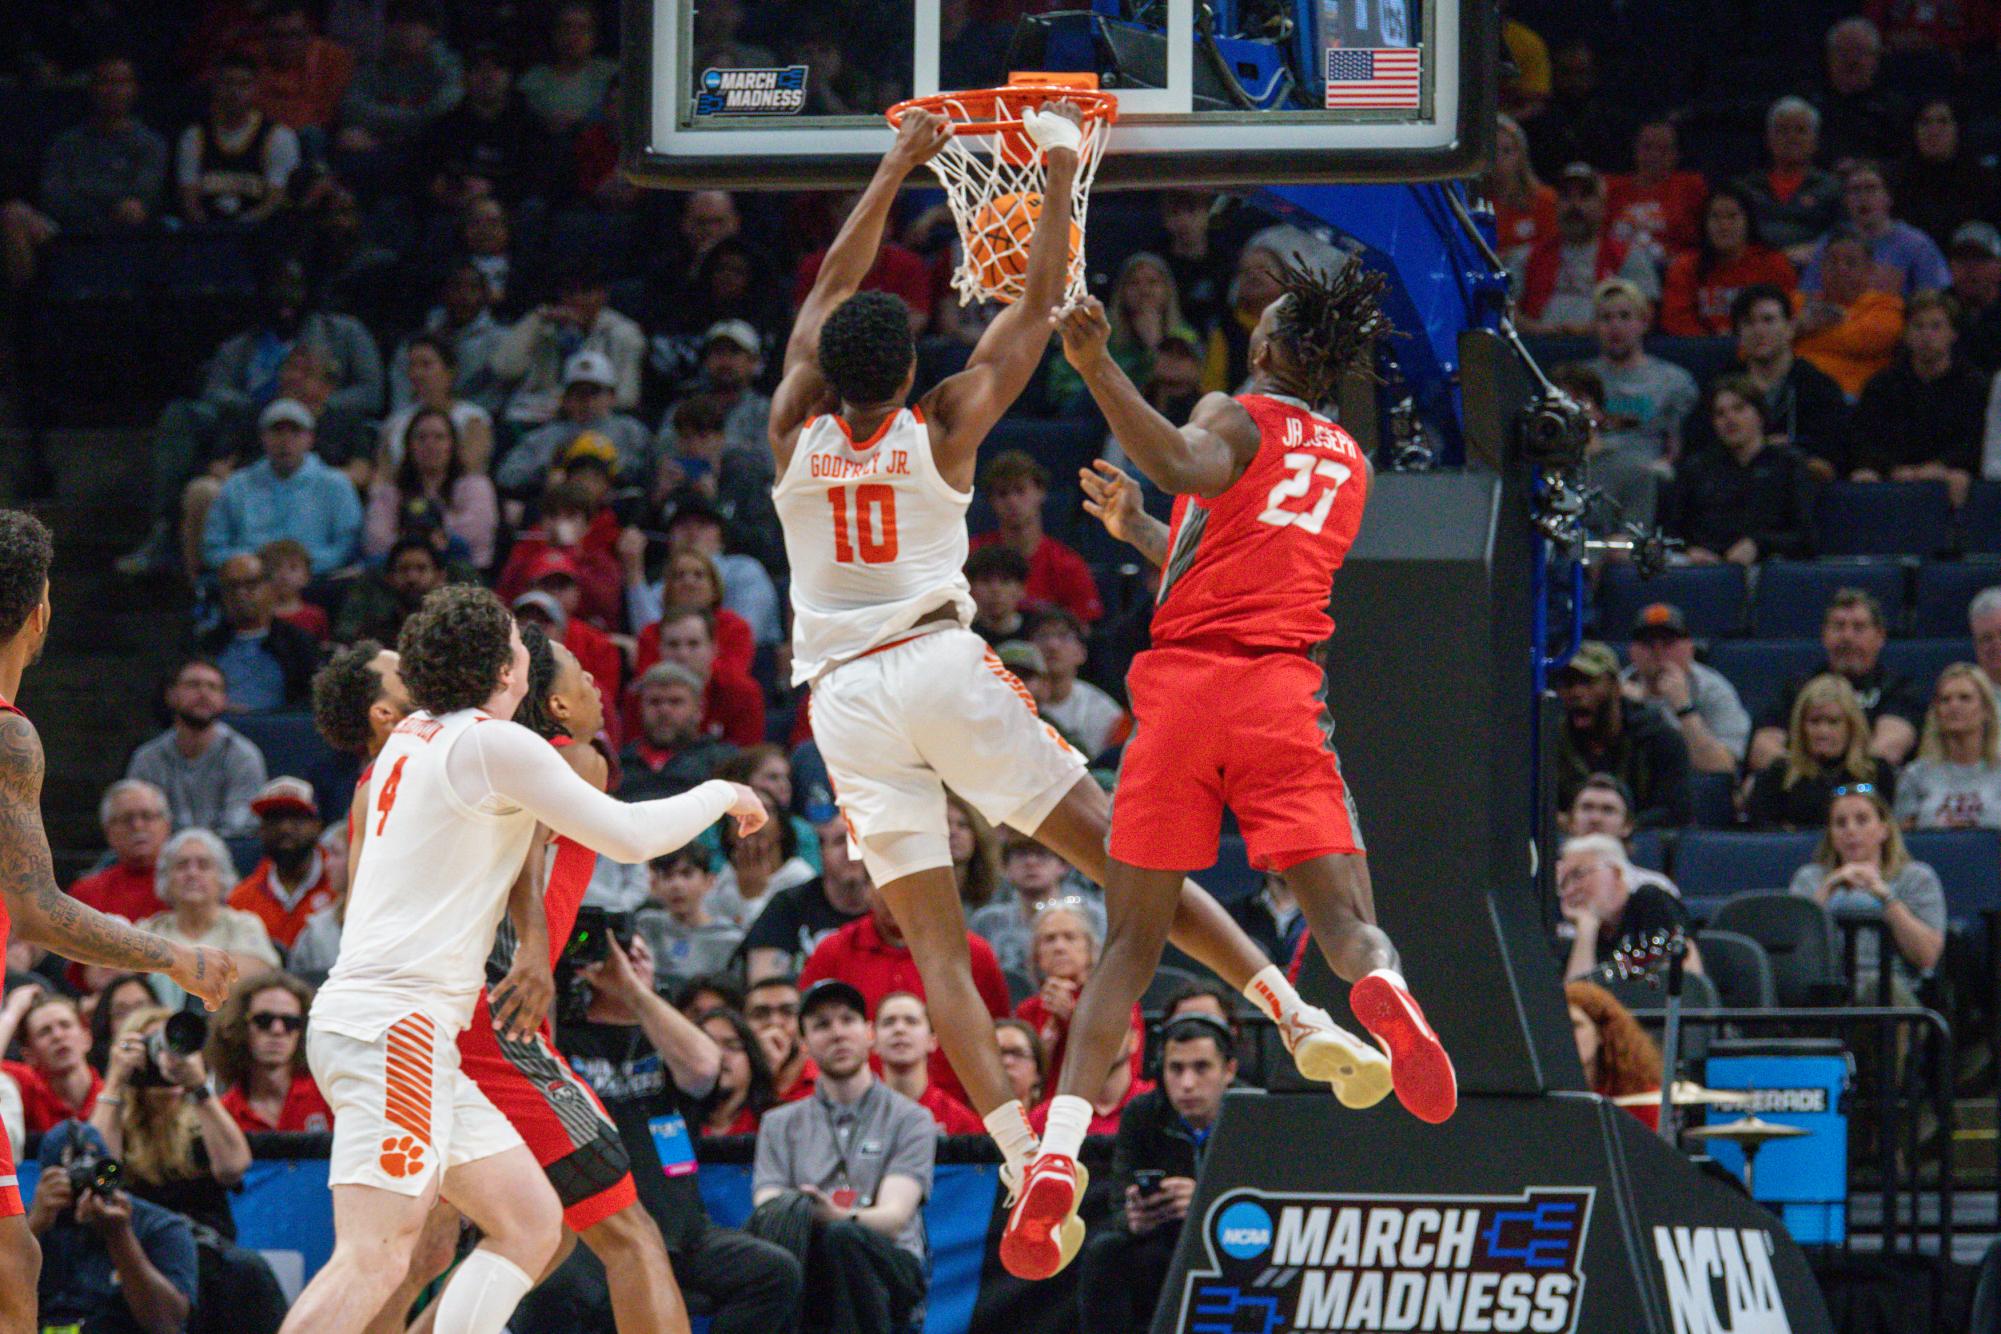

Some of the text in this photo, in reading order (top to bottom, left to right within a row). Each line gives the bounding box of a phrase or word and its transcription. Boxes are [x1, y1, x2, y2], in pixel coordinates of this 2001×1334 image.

[721, 72, 777, 89] MARCH
[726, 89, 802, 107] MADNESS
[886, 449, 911, 475] JR.
[827, 484, 898, 564] 10
[376, 755, 408, 837] 4
[1222, 1228, 1271, 1246] NCAA
[1271, 1206, 1481, 1269] MARCH
[1293, 1270, 1576, 1331] MADNESS
[1652, 1225, 1793, 1334] NCAA
